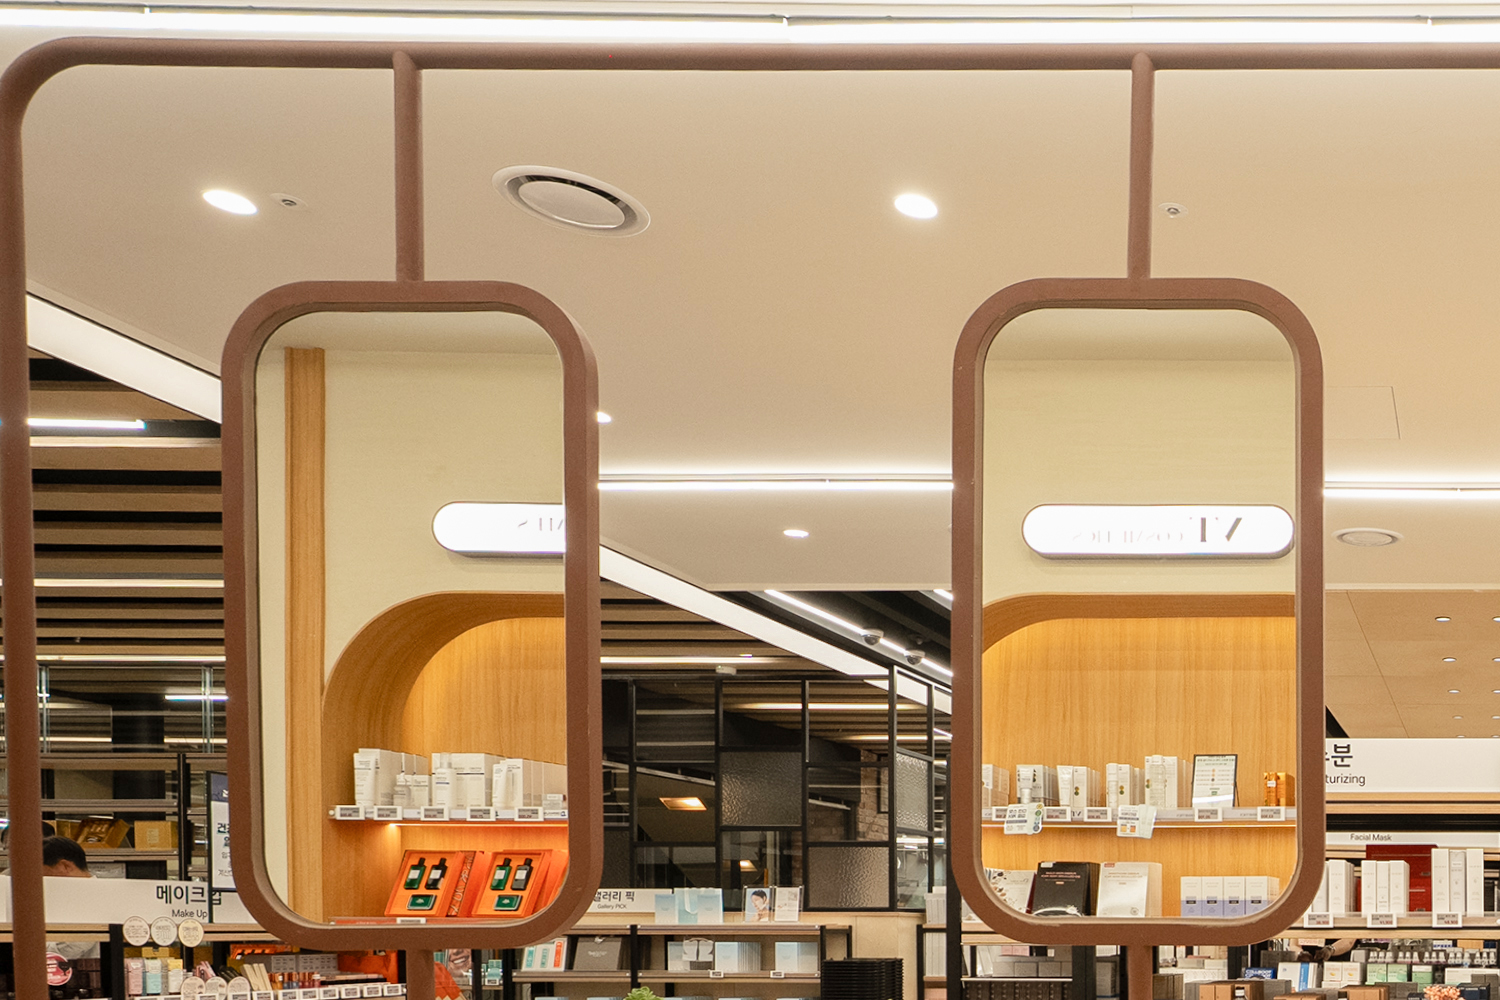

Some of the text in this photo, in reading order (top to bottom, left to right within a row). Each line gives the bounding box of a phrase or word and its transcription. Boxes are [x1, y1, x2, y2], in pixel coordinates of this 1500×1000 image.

[1325, 743, 1354, 768] 분
[1350, 833, 1392, 841] Facial Mask
[172, 909, 208, 919] Make Up
